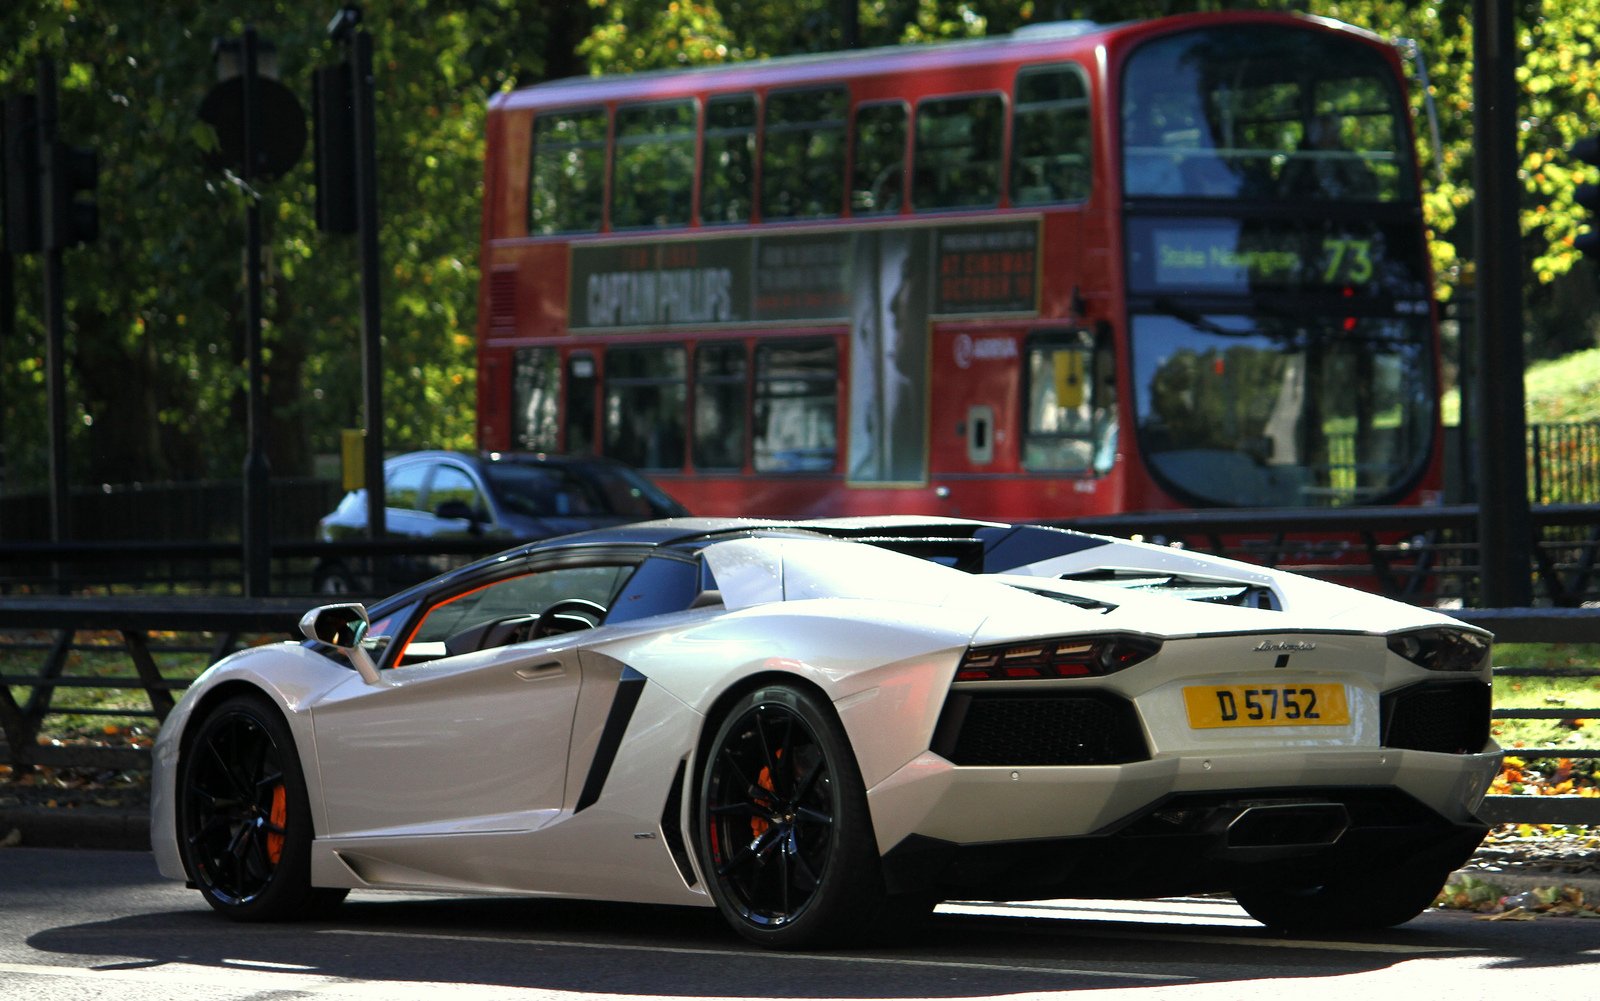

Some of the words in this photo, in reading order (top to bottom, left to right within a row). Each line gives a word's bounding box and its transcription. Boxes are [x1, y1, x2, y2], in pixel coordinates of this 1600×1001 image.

[1321, 240, 1371, 283] 73
[587, 271, 656, 326] CAPTAIN
[659, 267, 733, 323] PHILLIPS
[1216, 691, 1239, 722] D
[1245, 688, 1321, 720] 5752
